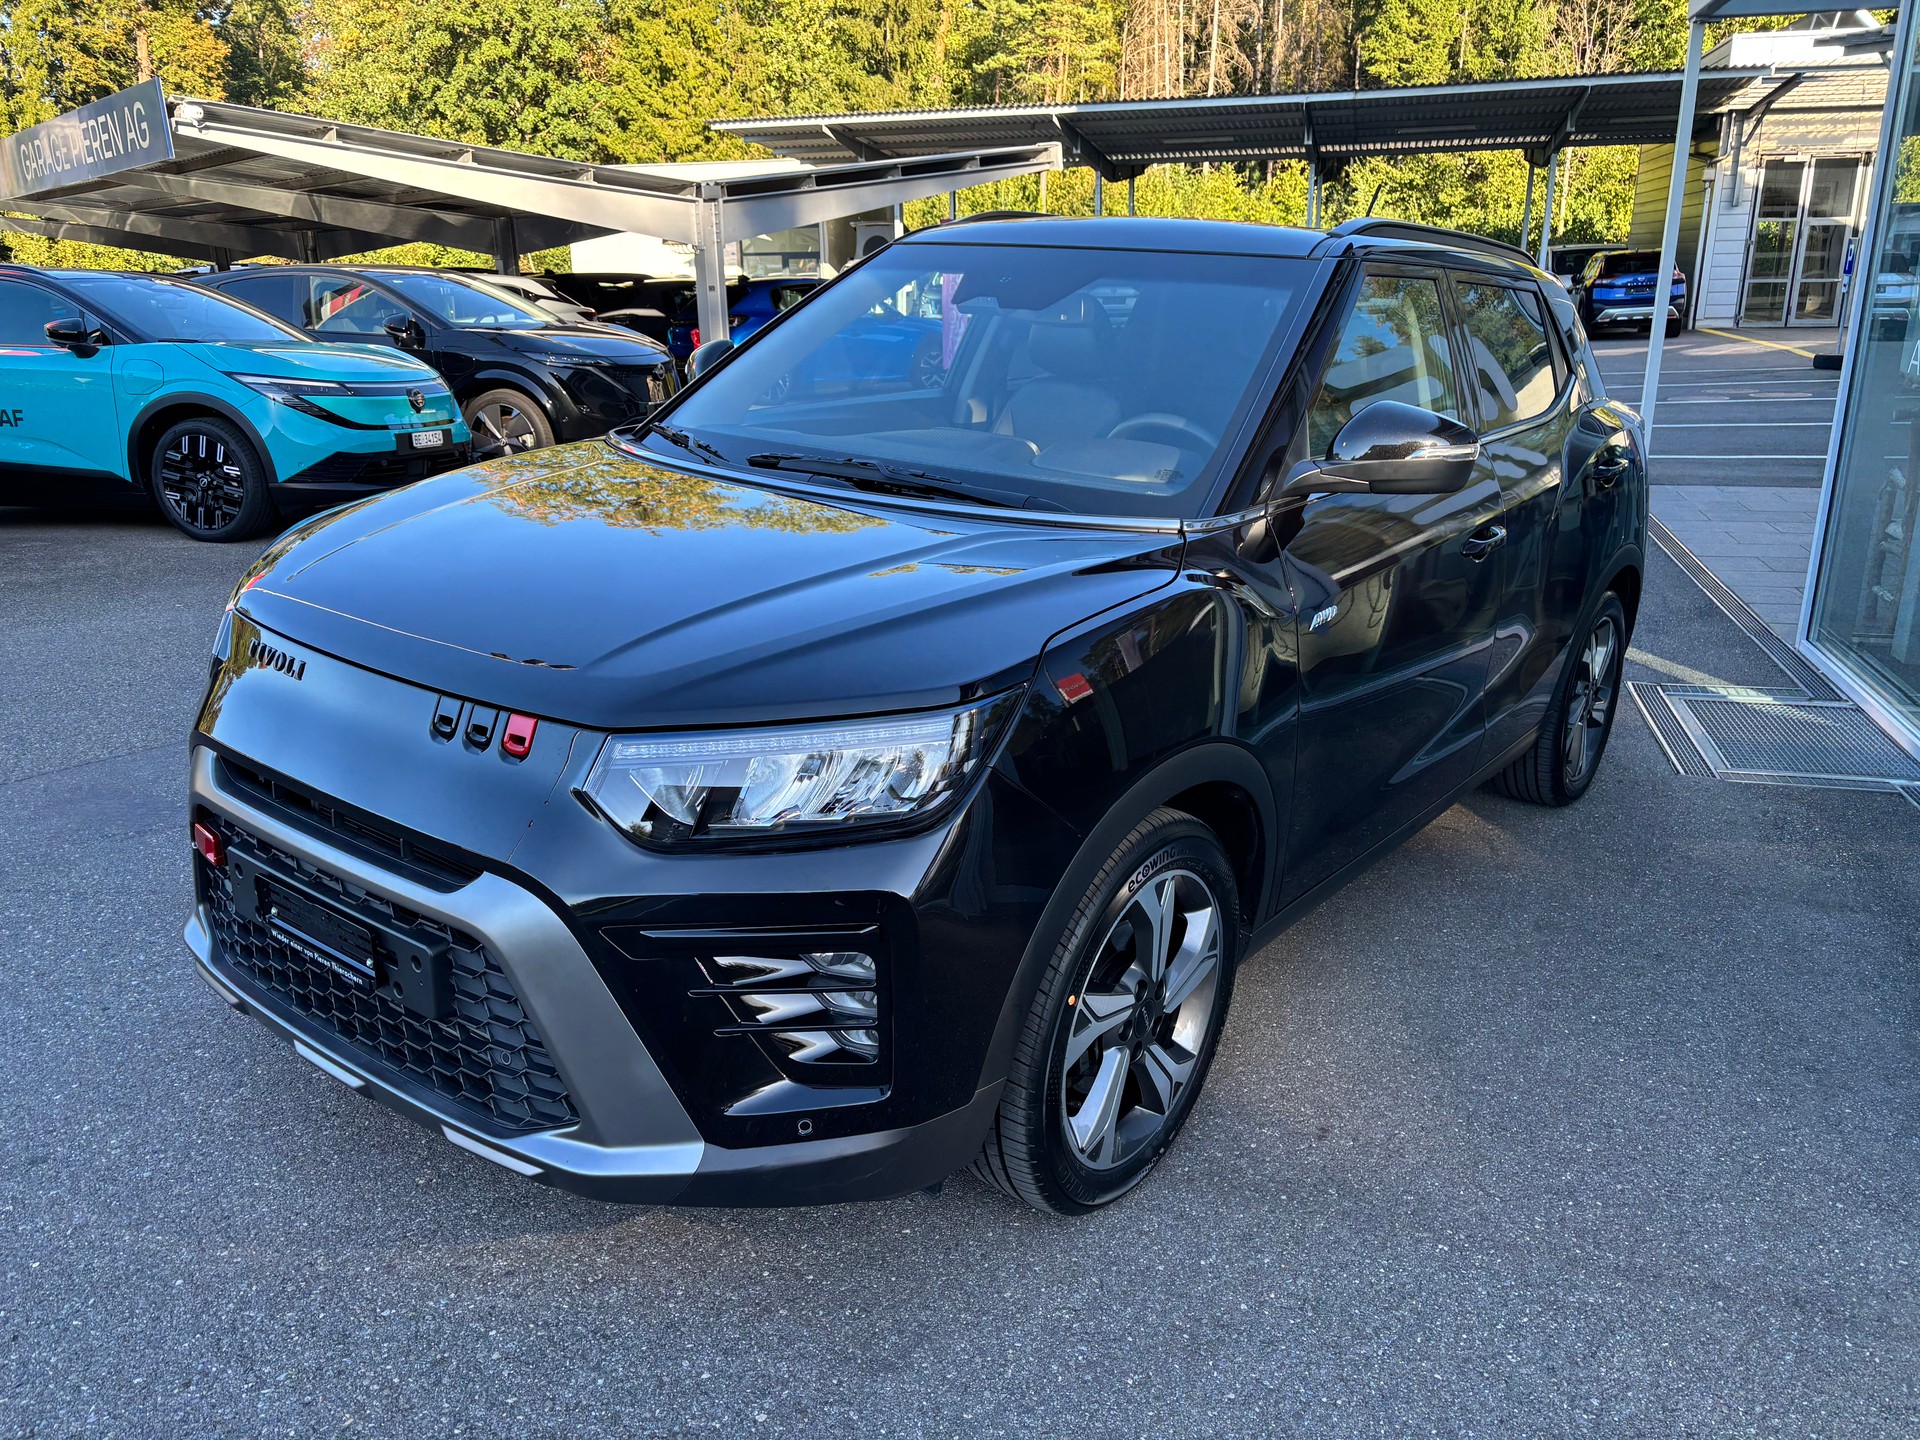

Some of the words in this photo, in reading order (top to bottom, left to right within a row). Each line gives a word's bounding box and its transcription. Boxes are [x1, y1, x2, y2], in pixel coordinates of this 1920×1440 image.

[20, 134, 70, 181] GARAGE
[70, 111, 124, 167] PIEREN
[124, 101, 150, 153] AG
[249, 637, 307, 681] TIVOLI
[304, 947, 314, 958] von
